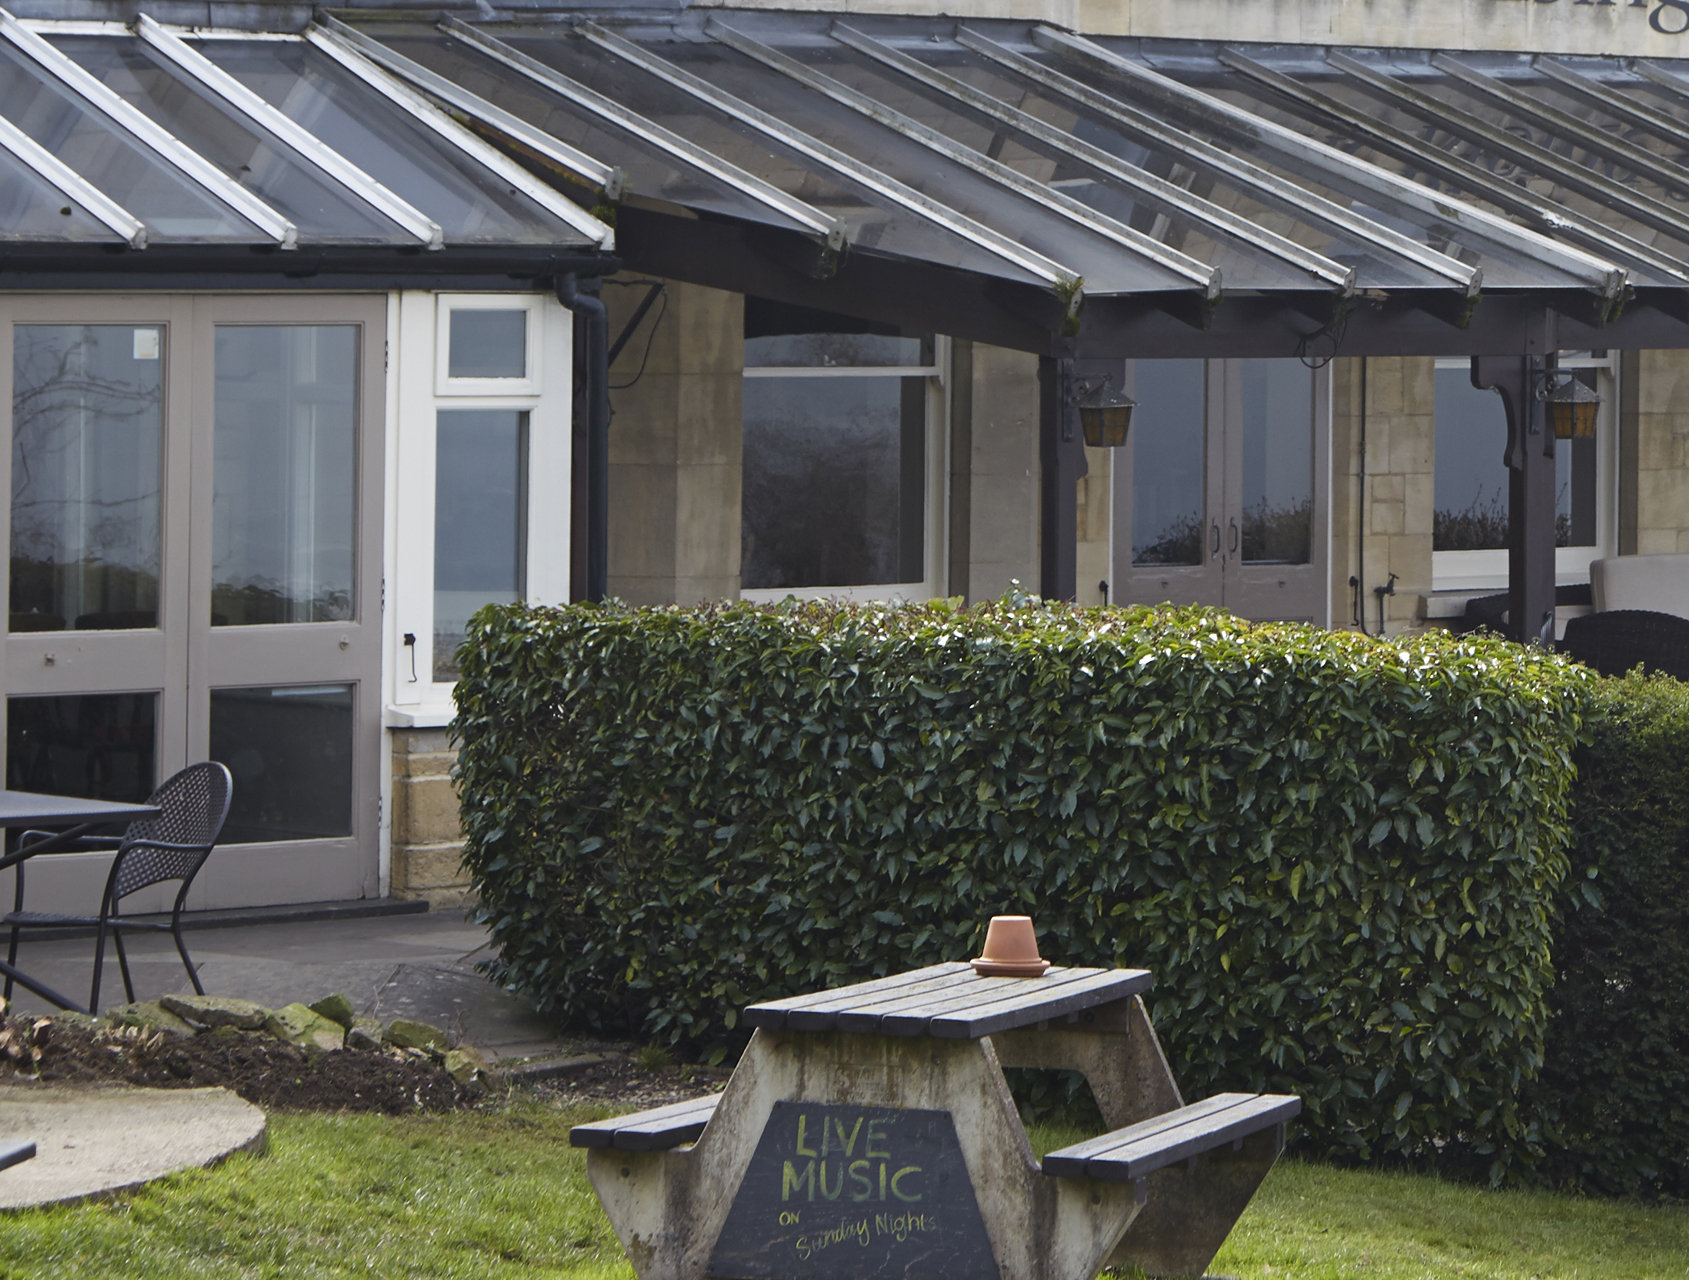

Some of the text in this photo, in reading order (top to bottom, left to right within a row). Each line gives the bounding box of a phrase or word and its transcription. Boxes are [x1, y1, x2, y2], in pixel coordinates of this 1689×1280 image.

[796, 1114, 893, 1160] LIVE
[781, 1159, 923, 1203] MUSIC
[795, 1210, 937, 1262] Sunday Nights
